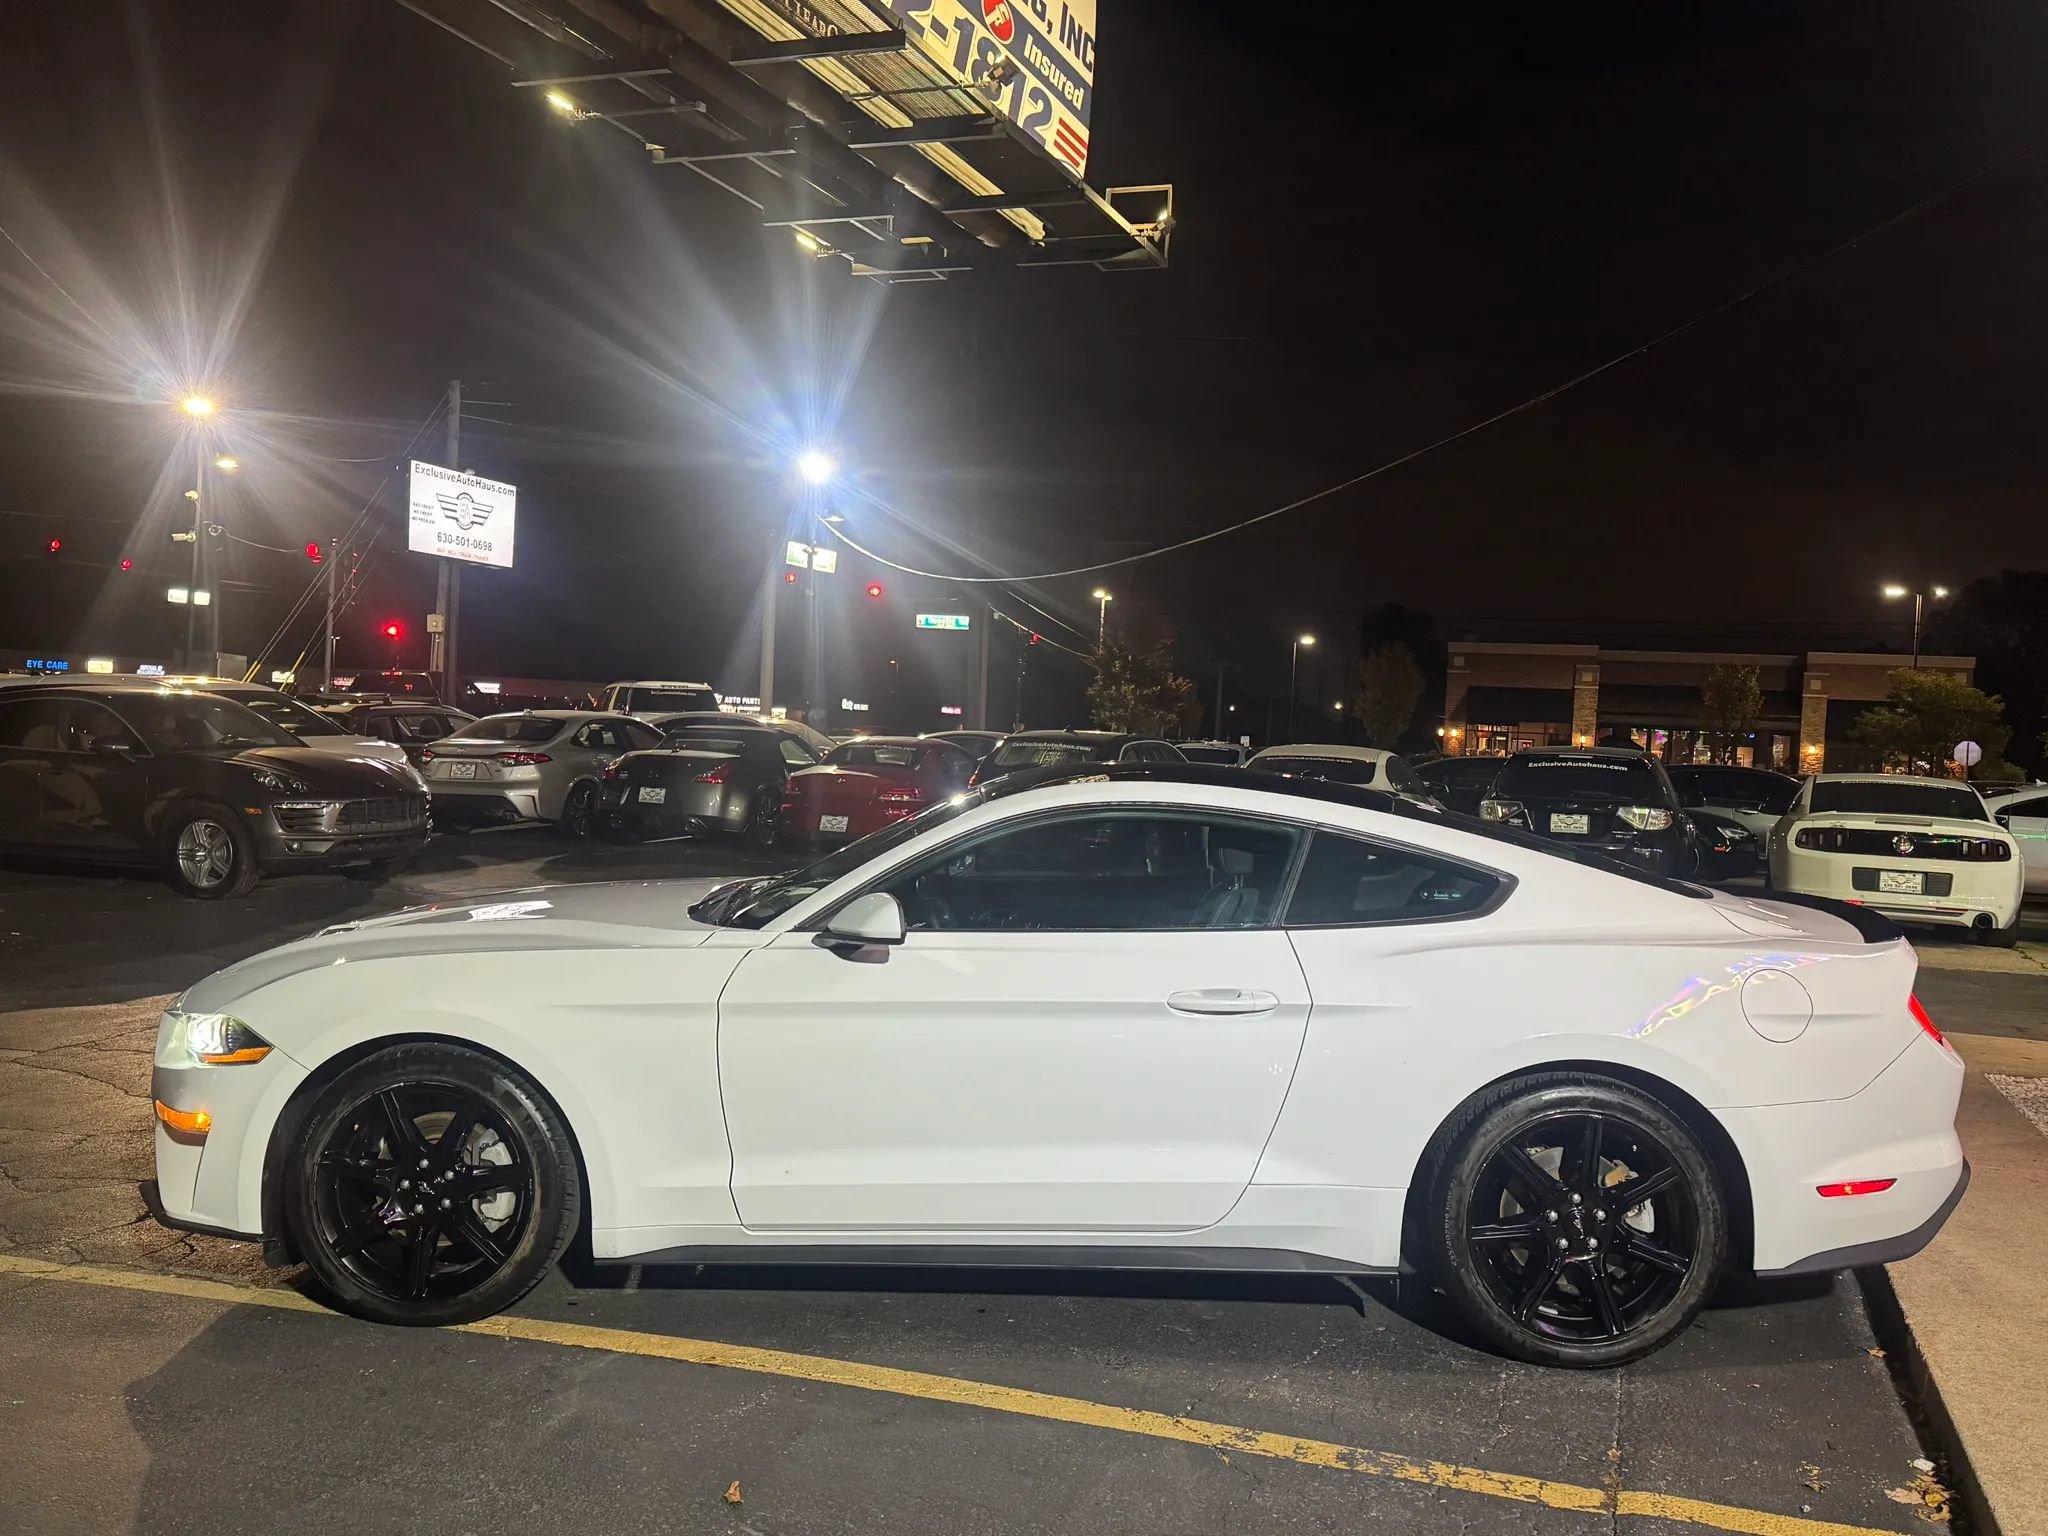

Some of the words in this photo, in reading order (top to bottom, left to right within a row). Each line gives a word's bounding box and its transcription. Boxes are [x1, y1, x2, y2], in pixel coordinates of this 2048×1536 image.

[1023, 33, 1084, 110] Insured
[415, 463, 515, 497] ExclusiveAutoHaus.com
[437, 532, 493, 552] 630-501-0698
[26, 660, 43, 669] EYE
[46, 661, 69, 670] CARE
[724, 696, 741, 704] AUTO
[1528, 761, 1628, 772] ExclusiveAutohaus.com
